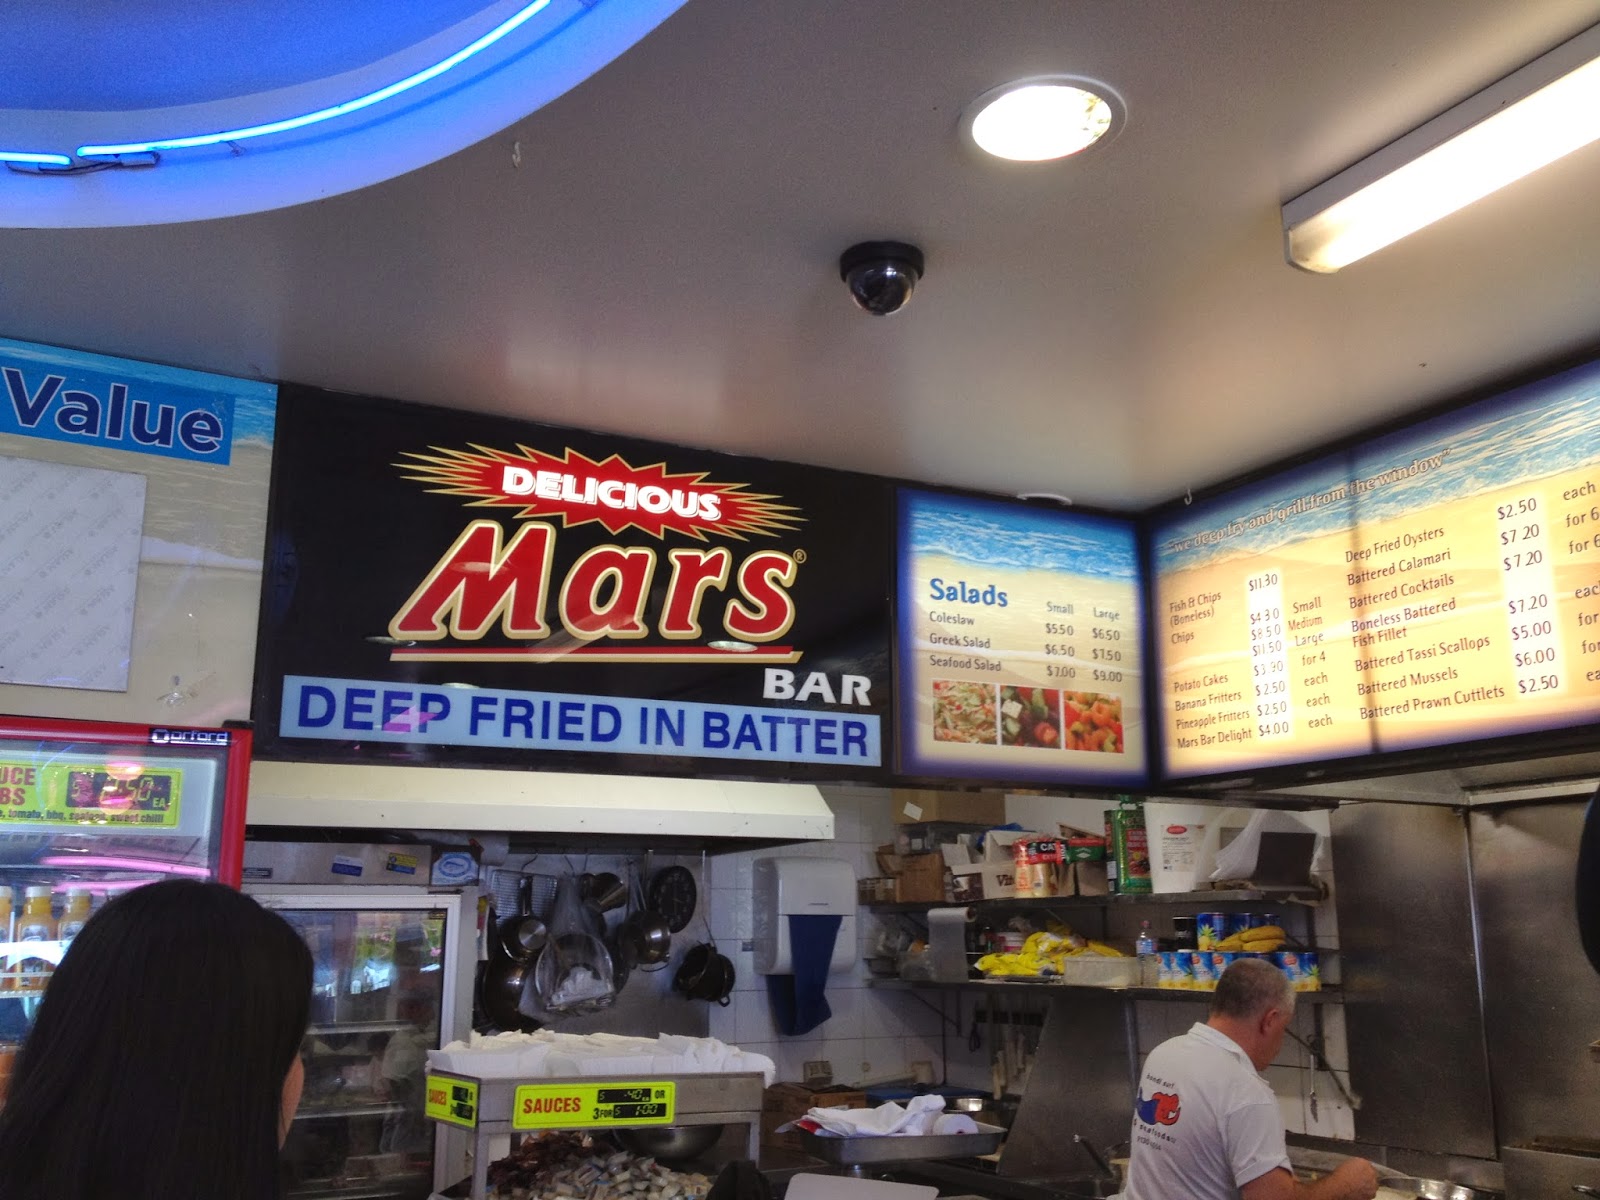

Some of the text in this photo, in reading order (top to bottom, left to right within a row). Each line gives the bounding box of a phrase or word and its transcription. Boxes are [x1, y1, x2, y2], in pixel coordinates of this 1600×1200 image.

[1, 366, 224, 454] Value
[501, 465, 722, 520] DELICIOUS
[1563, 481, 1597, 501] each
[1194, 527, 1225, 546] deep
[1227, 518, 1248, 537] fry
[1249, 509, 1275, 529] and
[1308, 486, 1346, 509] from
[1350, 475, 1376, 496] the
[1497, 497, 1537, 521] $2.50
[1566, 506, 1600, 528] for 6
[1345, 527, 1445, 563] Deep Fried Oysters
[1569, 538, 1590, 555] for
[1346, 548, 1451, 586] Battered Calamari
[388, 518, 799, 642] Mars
[1248, 573, 1278, 592] $11.30
[1575, 580, 1600, 600] eac
[929, 577, 1008, 608] Salads
[1349, 572, 1455, 610] Battered Cocktails
[1046, 601, 1120, 622] Small Large
[1169, 592, 1222, 614] Fish & Chips
[1293, 596, 1322, 614] Small
[1508, 594, 1548, 615] $7.20
[929, 611, 975, 626] Coleslaw
[1170, 606, 1215, 628] (Boneless)
[1250, 607, 1280, 625] $430
[1288, 616, 1323, 632] Medium
[1351, 597, 1457, 633] Boneless Battered
[1578, 610, 1600, 627] for
[929, 633, 991, 649] Greek Salad
[1092, 627, 1120, 641] $6.50
[1171, 630, 1195, 645] Chips
[1295, 632, 1324, 648] Large
[1352, 626, 1408, 648] Fish Fillet
[1511, 620, 1552, 641] $5.00
[1045, 643, 1075, 657] $6.50
[1252, 639, 1282, 657] $11.50
[1302, 650, 1326, 667] for 4
[1355, 635, 1491, 672] Battered Tassi Scallops
[1514, 647, 1556, 668] $6.00
[929, 655, 1001, 672] Seafood Salad
[1046, 665, 1076, 679] $7.00
[762, 667, 872, 706] BAR
[1174, 673, 1229, 693] Potato Cakes
[1255, 680, 1286, 697] $2.50
[1304, 671, 1329, 687] each
[1357, 667, 1459, 696] Battered Mussels
[1518, 674, 1559, 695] $2.50
[1175, 690, 1242, 712] Banana Fritters
[1257, 700, 1287, 717] $2.50
[1306, 693, 1331, 708] each
[1360, 684, 1506, 720] Battered Prawn Cuttlets
[297, 684, 869, 757] DEEP FRIED IN BATTER
[1176, 709, 1250, 731] Pineapple Fritters
[1258, 721, 1289, 737] $4.00
[1308, 713, 1333, 729] each
[1177, 727, 1253, 750] Mars Bar Delight
[523, 1098, 581, 1114] SAUCES
